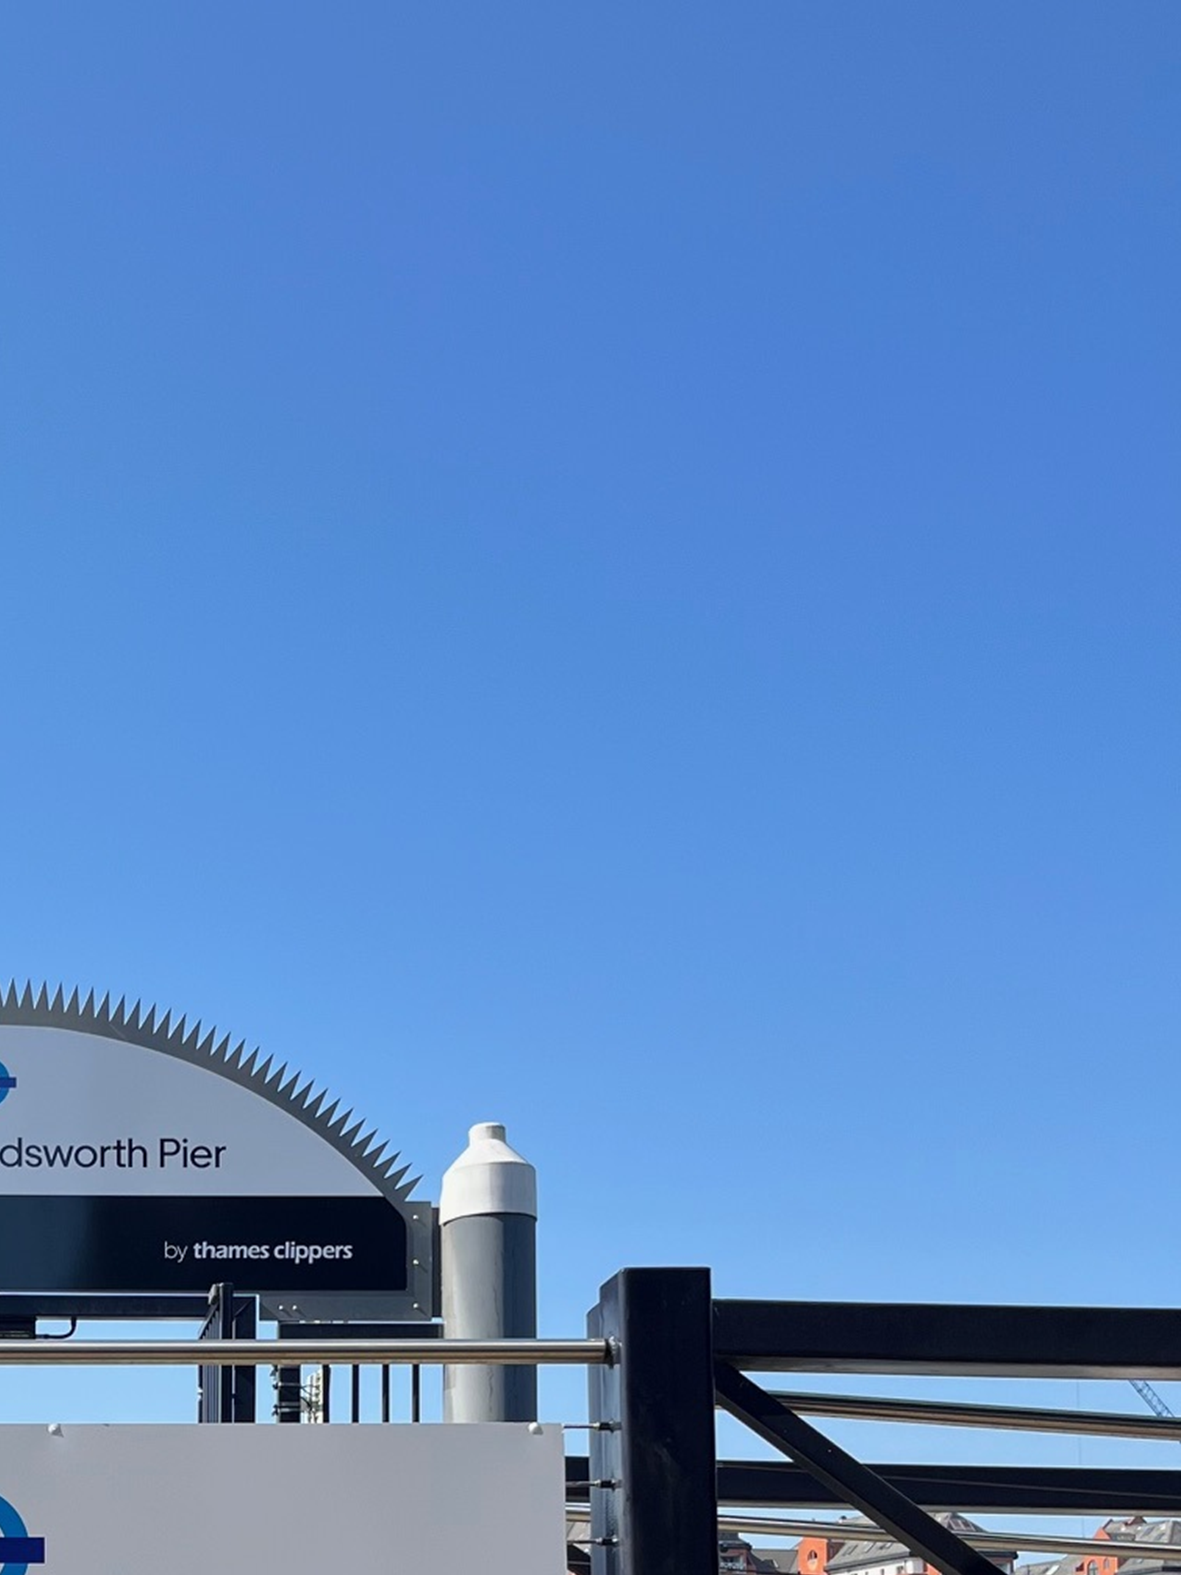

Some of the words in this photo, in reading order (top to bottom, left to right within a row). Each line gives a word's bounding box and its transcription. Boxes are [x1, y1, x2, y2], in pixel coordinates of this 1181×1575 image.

[159, 1137, 227, 1169] Pier
[164, 1241, 189, 1263] by
[192, 1241, 270, 1259] thames
[273, 1240, 353, 1265] clippers
